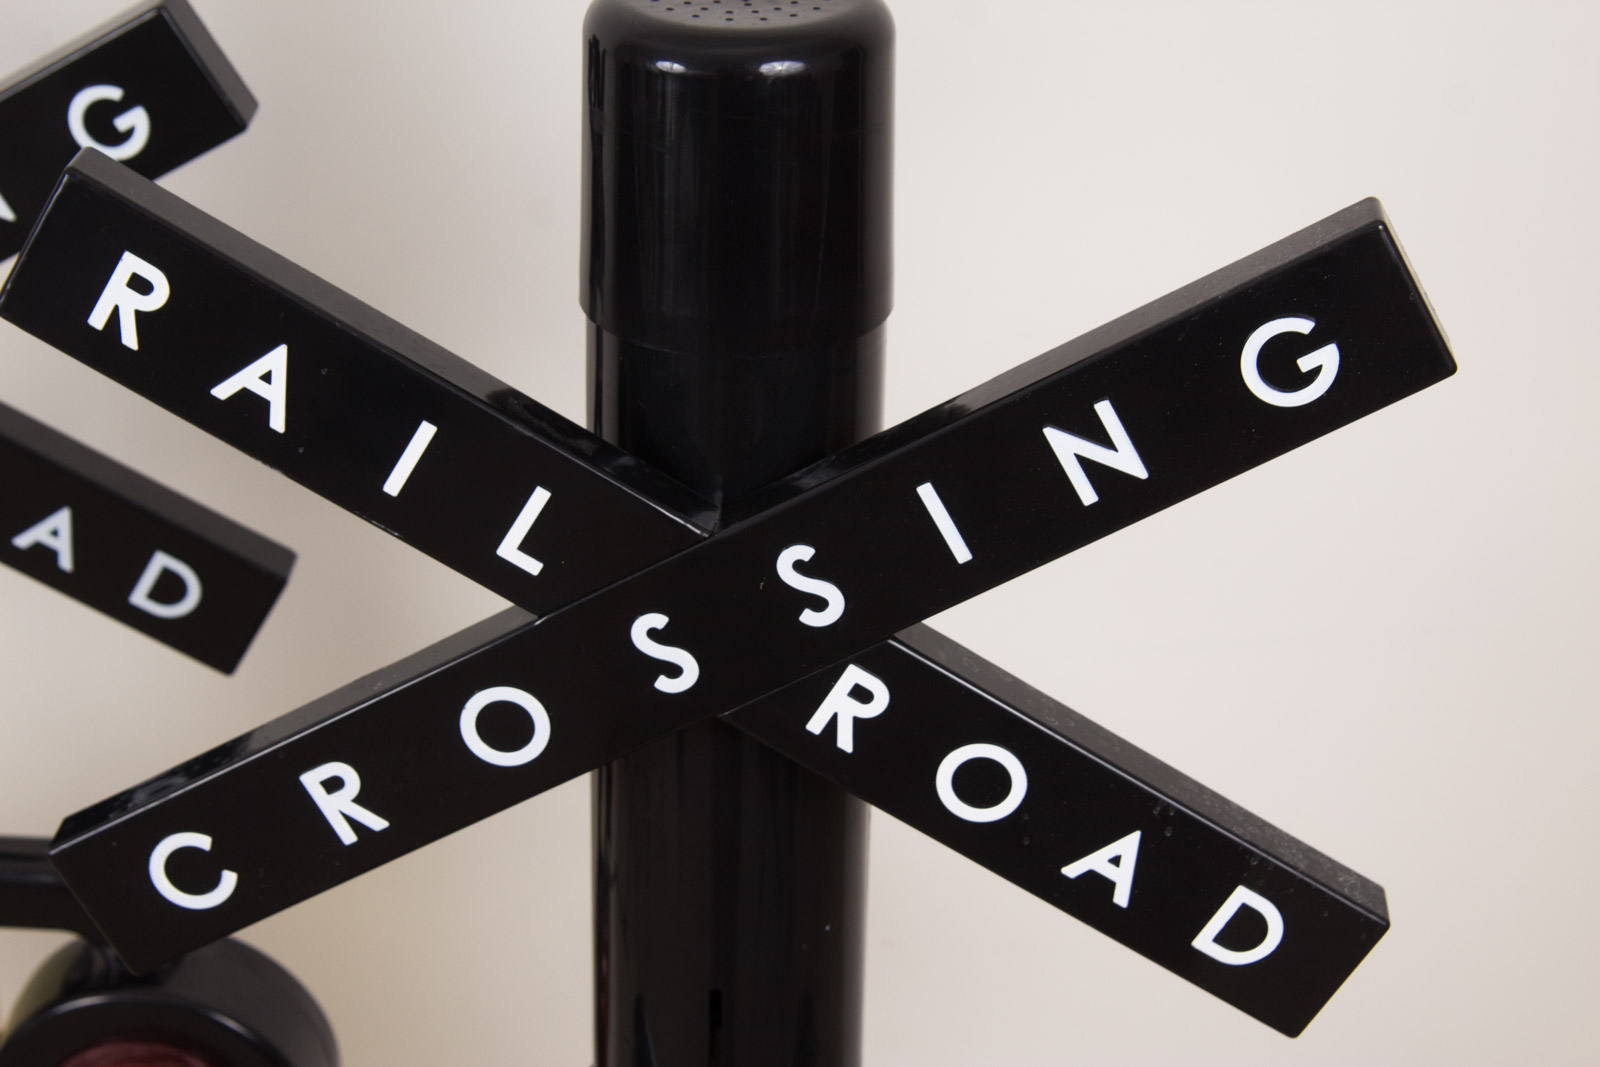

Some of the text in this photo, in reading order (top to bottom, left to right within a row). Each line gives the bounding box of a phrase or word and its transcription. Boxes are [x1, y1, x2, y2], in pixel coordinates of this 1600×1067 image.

[11, 506, 203, 619] AD
[87, 250, 1285, 967] RAIL ROAD
[148, 316, 1341, 911] CROSSING
